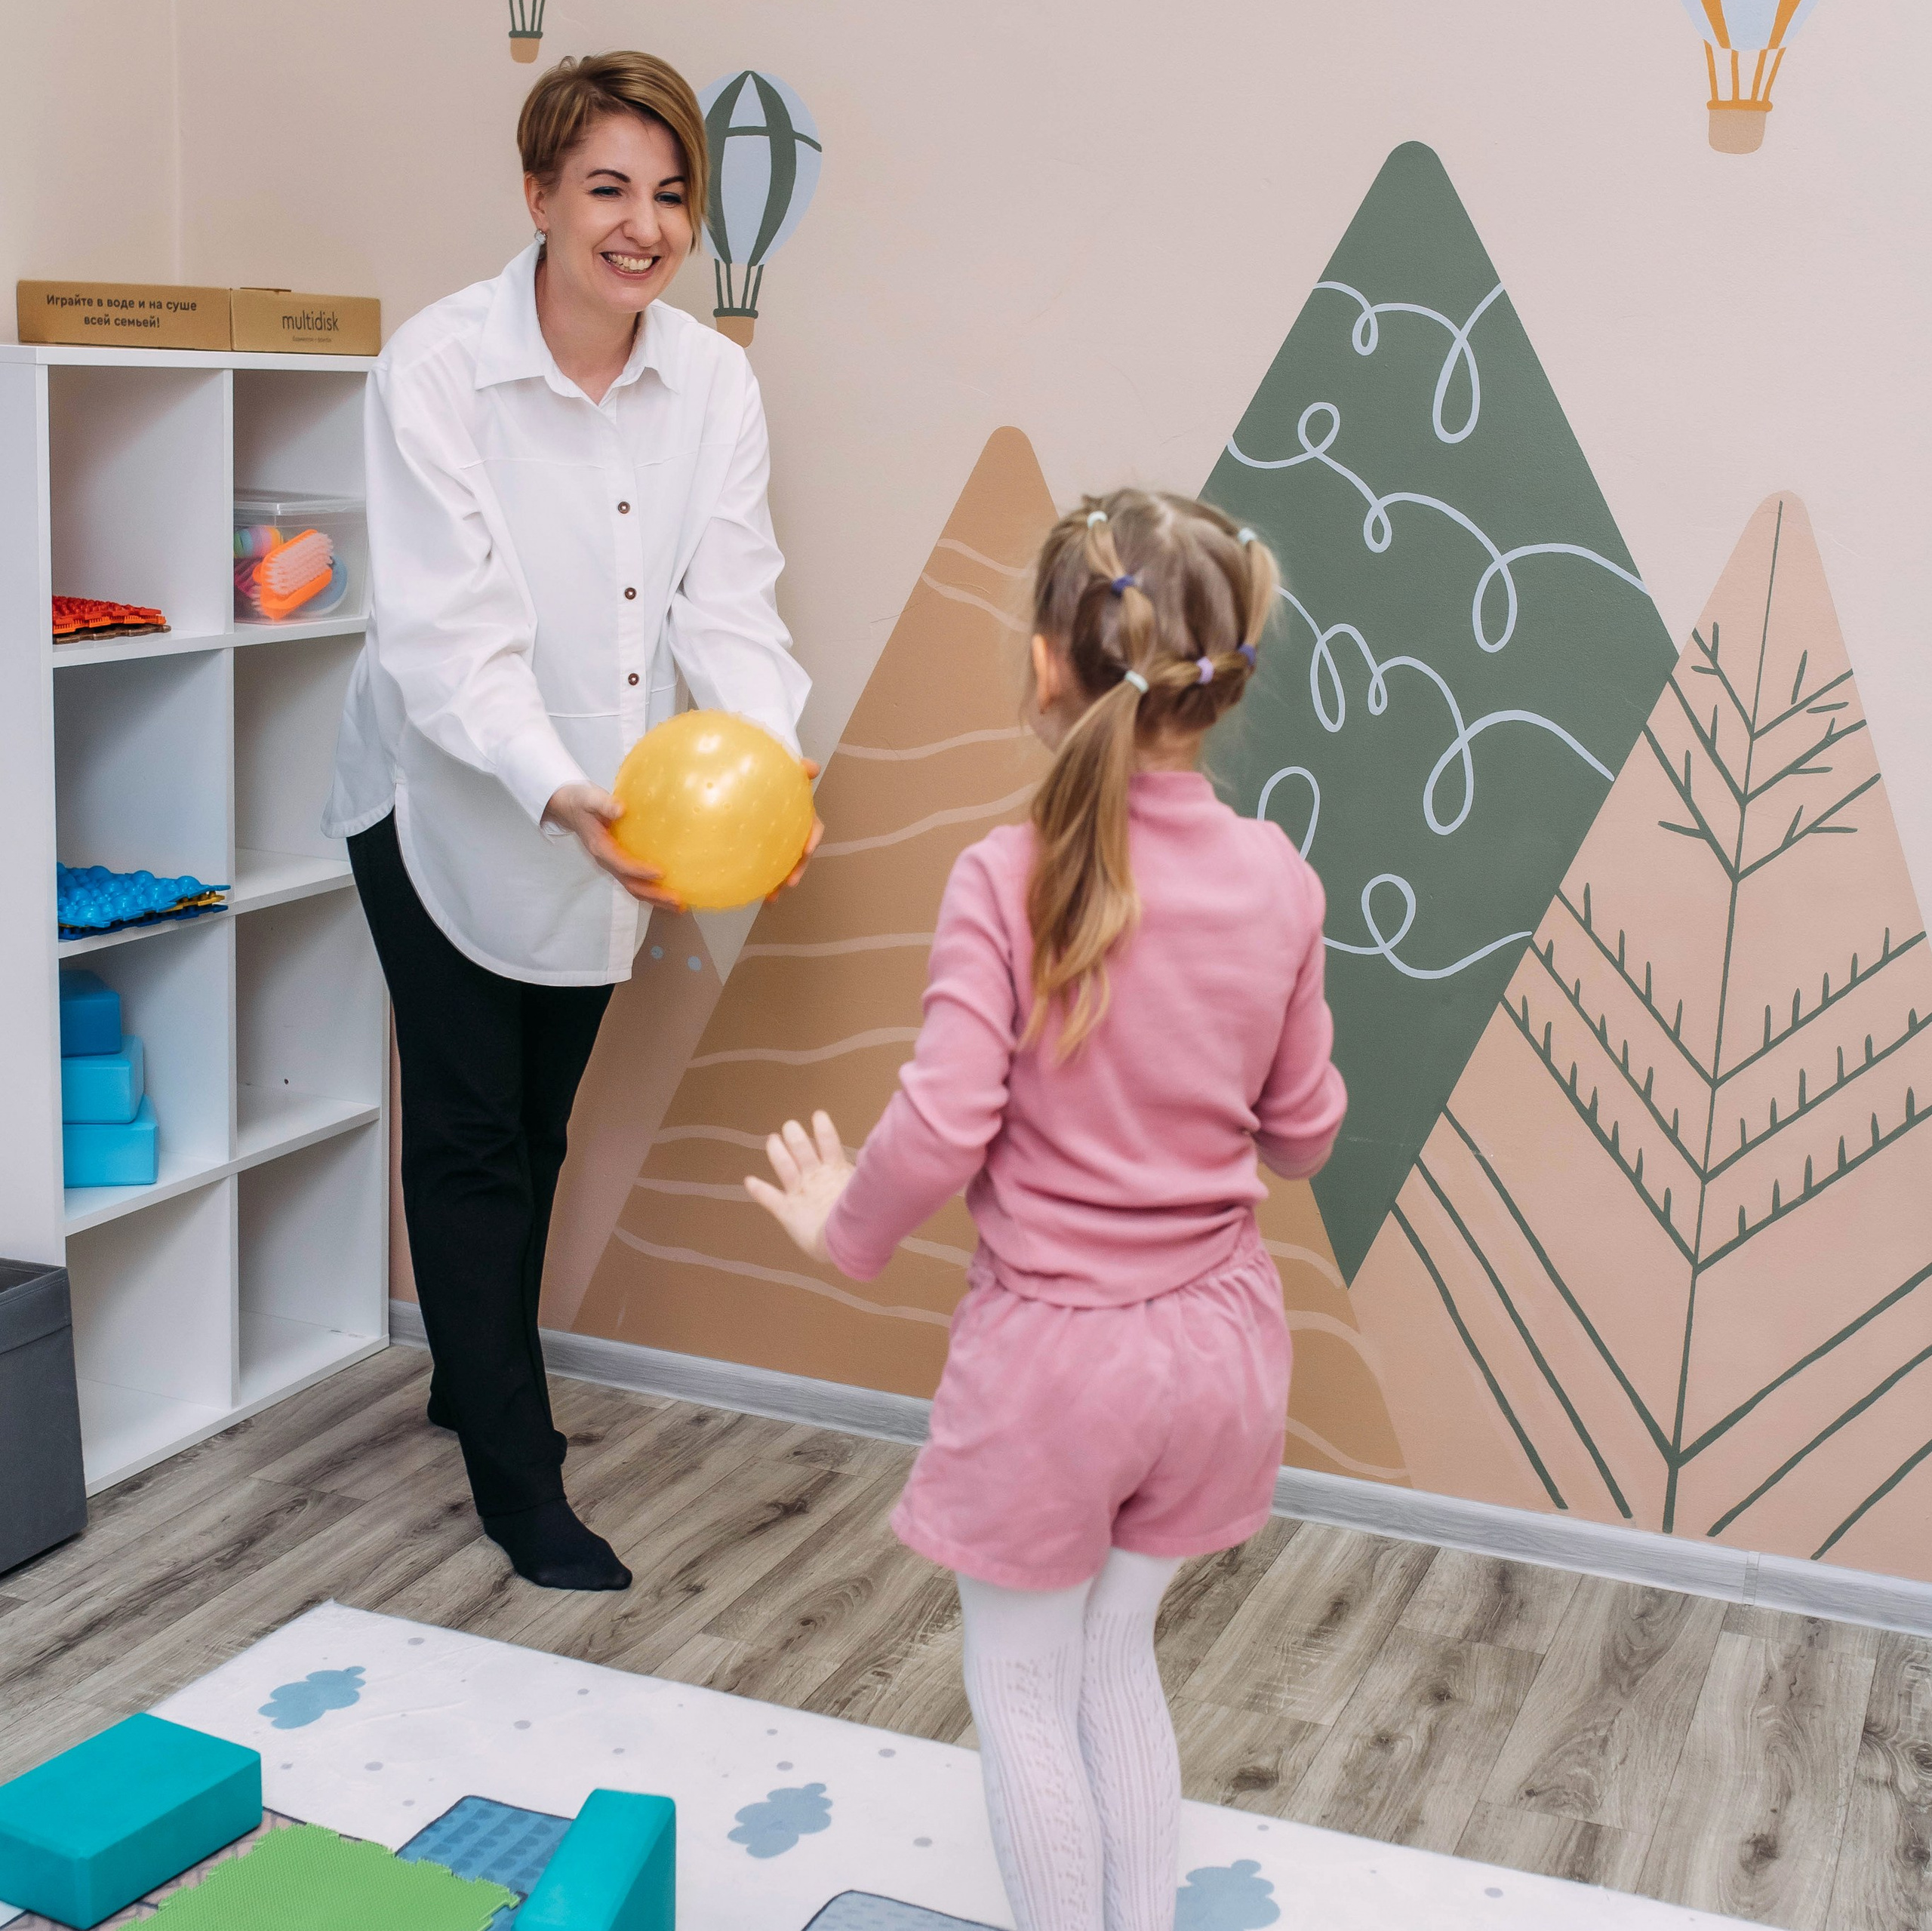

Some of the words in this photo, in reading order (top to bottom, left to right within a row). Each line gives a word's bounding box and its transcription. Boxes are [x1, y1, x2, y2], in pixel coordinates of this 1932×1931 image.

[47, 294, 93, 307] Играйте
[97, 298, 103, 307] в
[107, 298, 134, 310] воде
[138, 300, 145, 308] и
[149, 300, 162, 309] на
[166, 300, 197, 312] суше
[84, 314, 110, 326] всей
[114, 315, 160, 327] семьей!
[282, 309, 339, 331] multidisk
